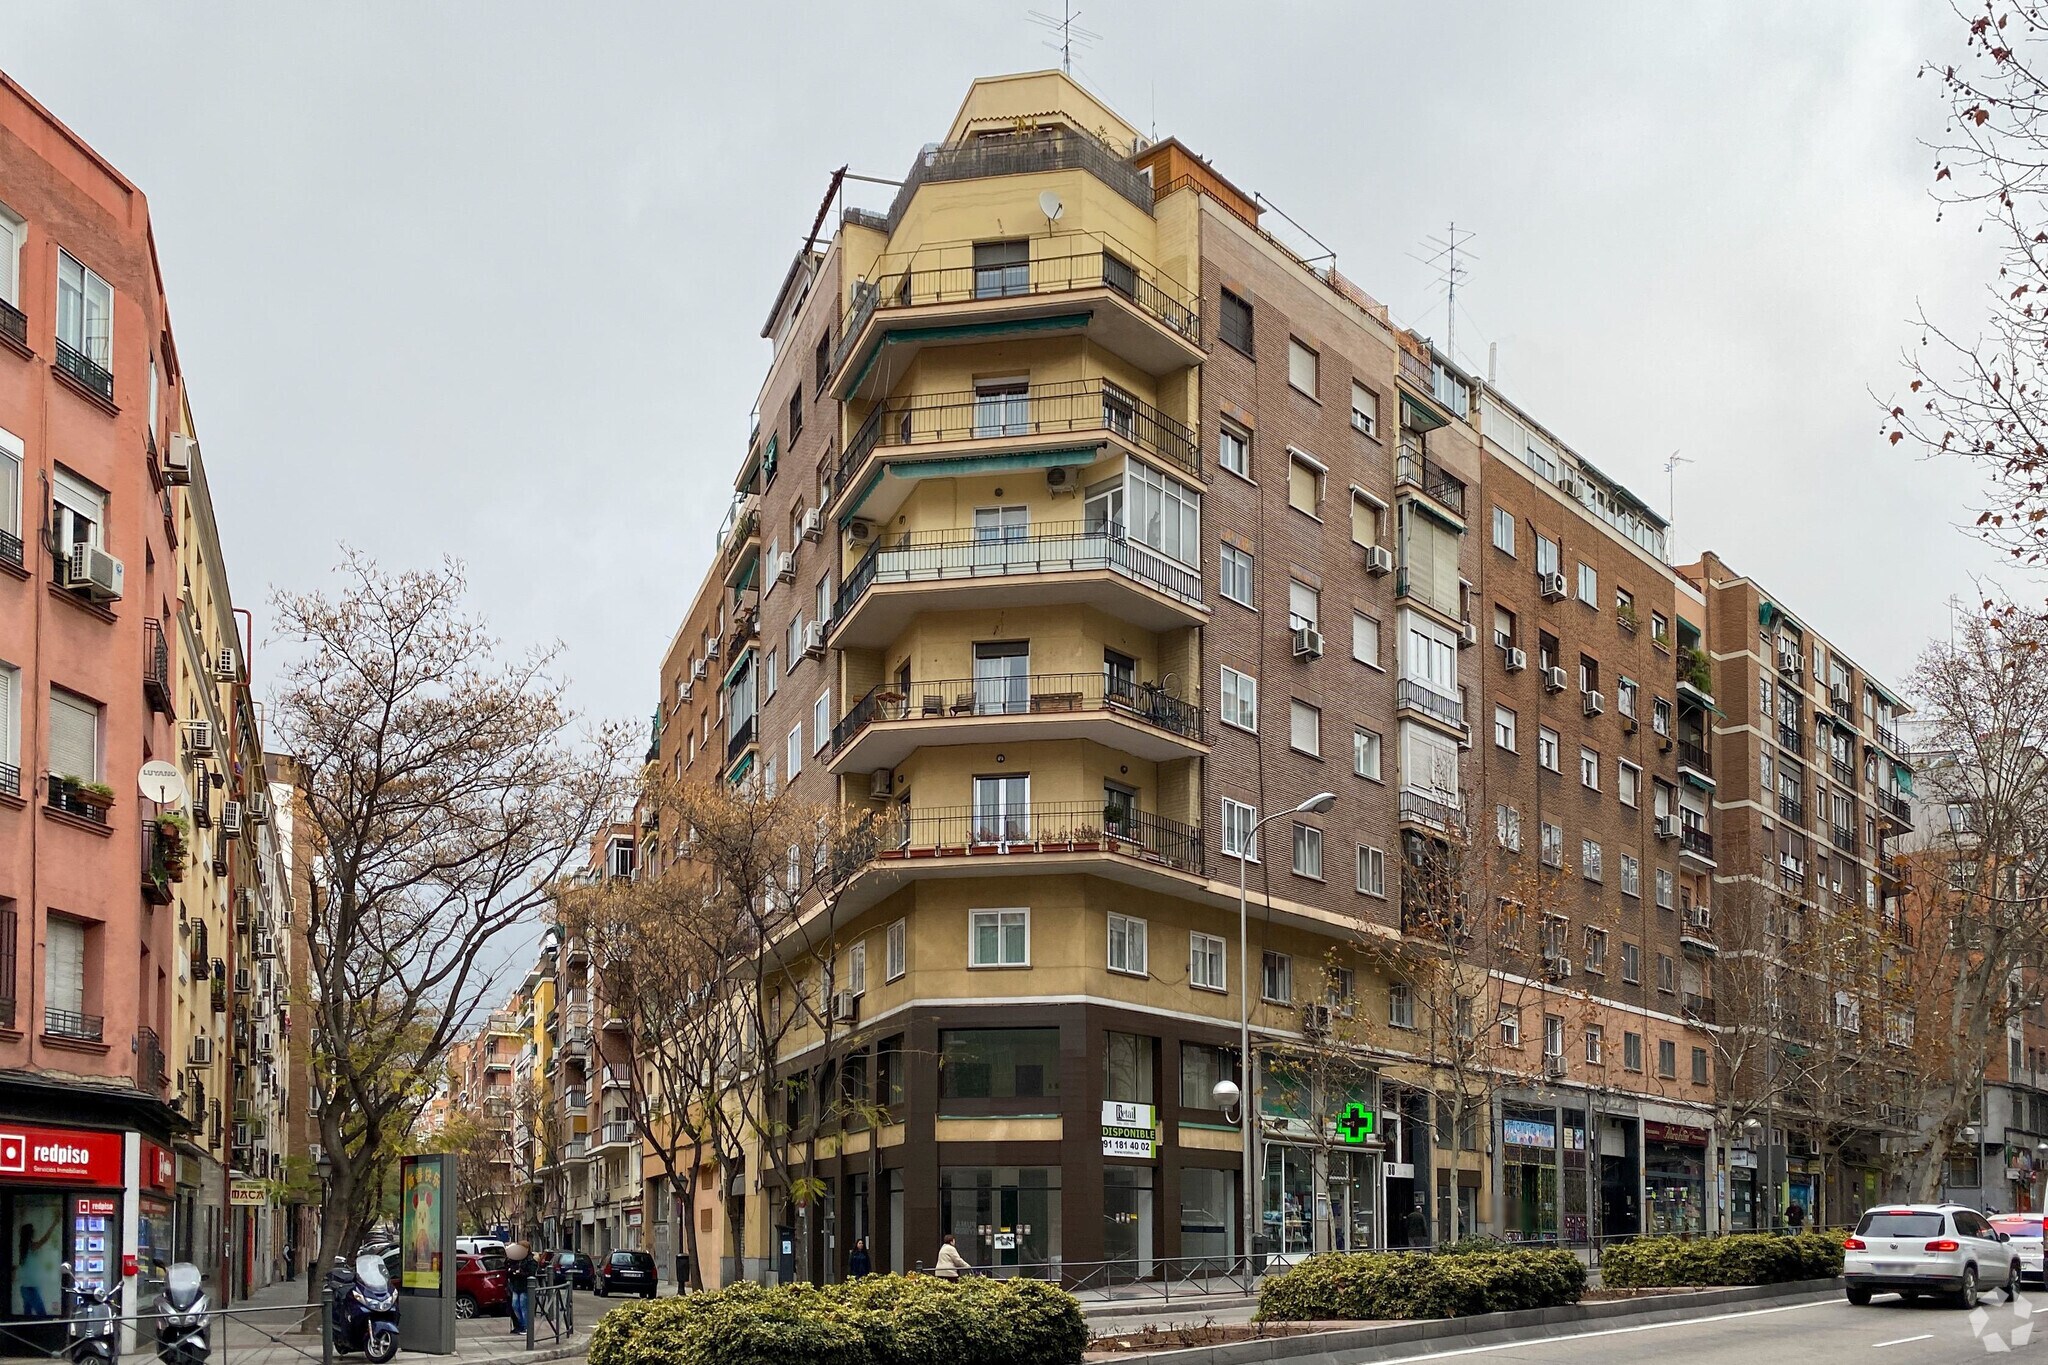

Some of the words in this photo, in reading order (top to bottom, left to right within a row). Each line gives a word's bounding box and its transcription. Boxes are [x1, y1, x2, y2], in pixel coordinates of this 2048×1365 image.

[1102, 1126, 1155, 1139] DISPONIBLE
[1103, 1140, 1112, 1148] 91
[1115, 1141, 1128, 1149] 181
[1130, 1142, 1139, 1150] 40
[1141, 1142, 1150, 1151] 02
[33, 1144, 90, 1165] redpiso
[231, 1189, 265, 1200] MACA
